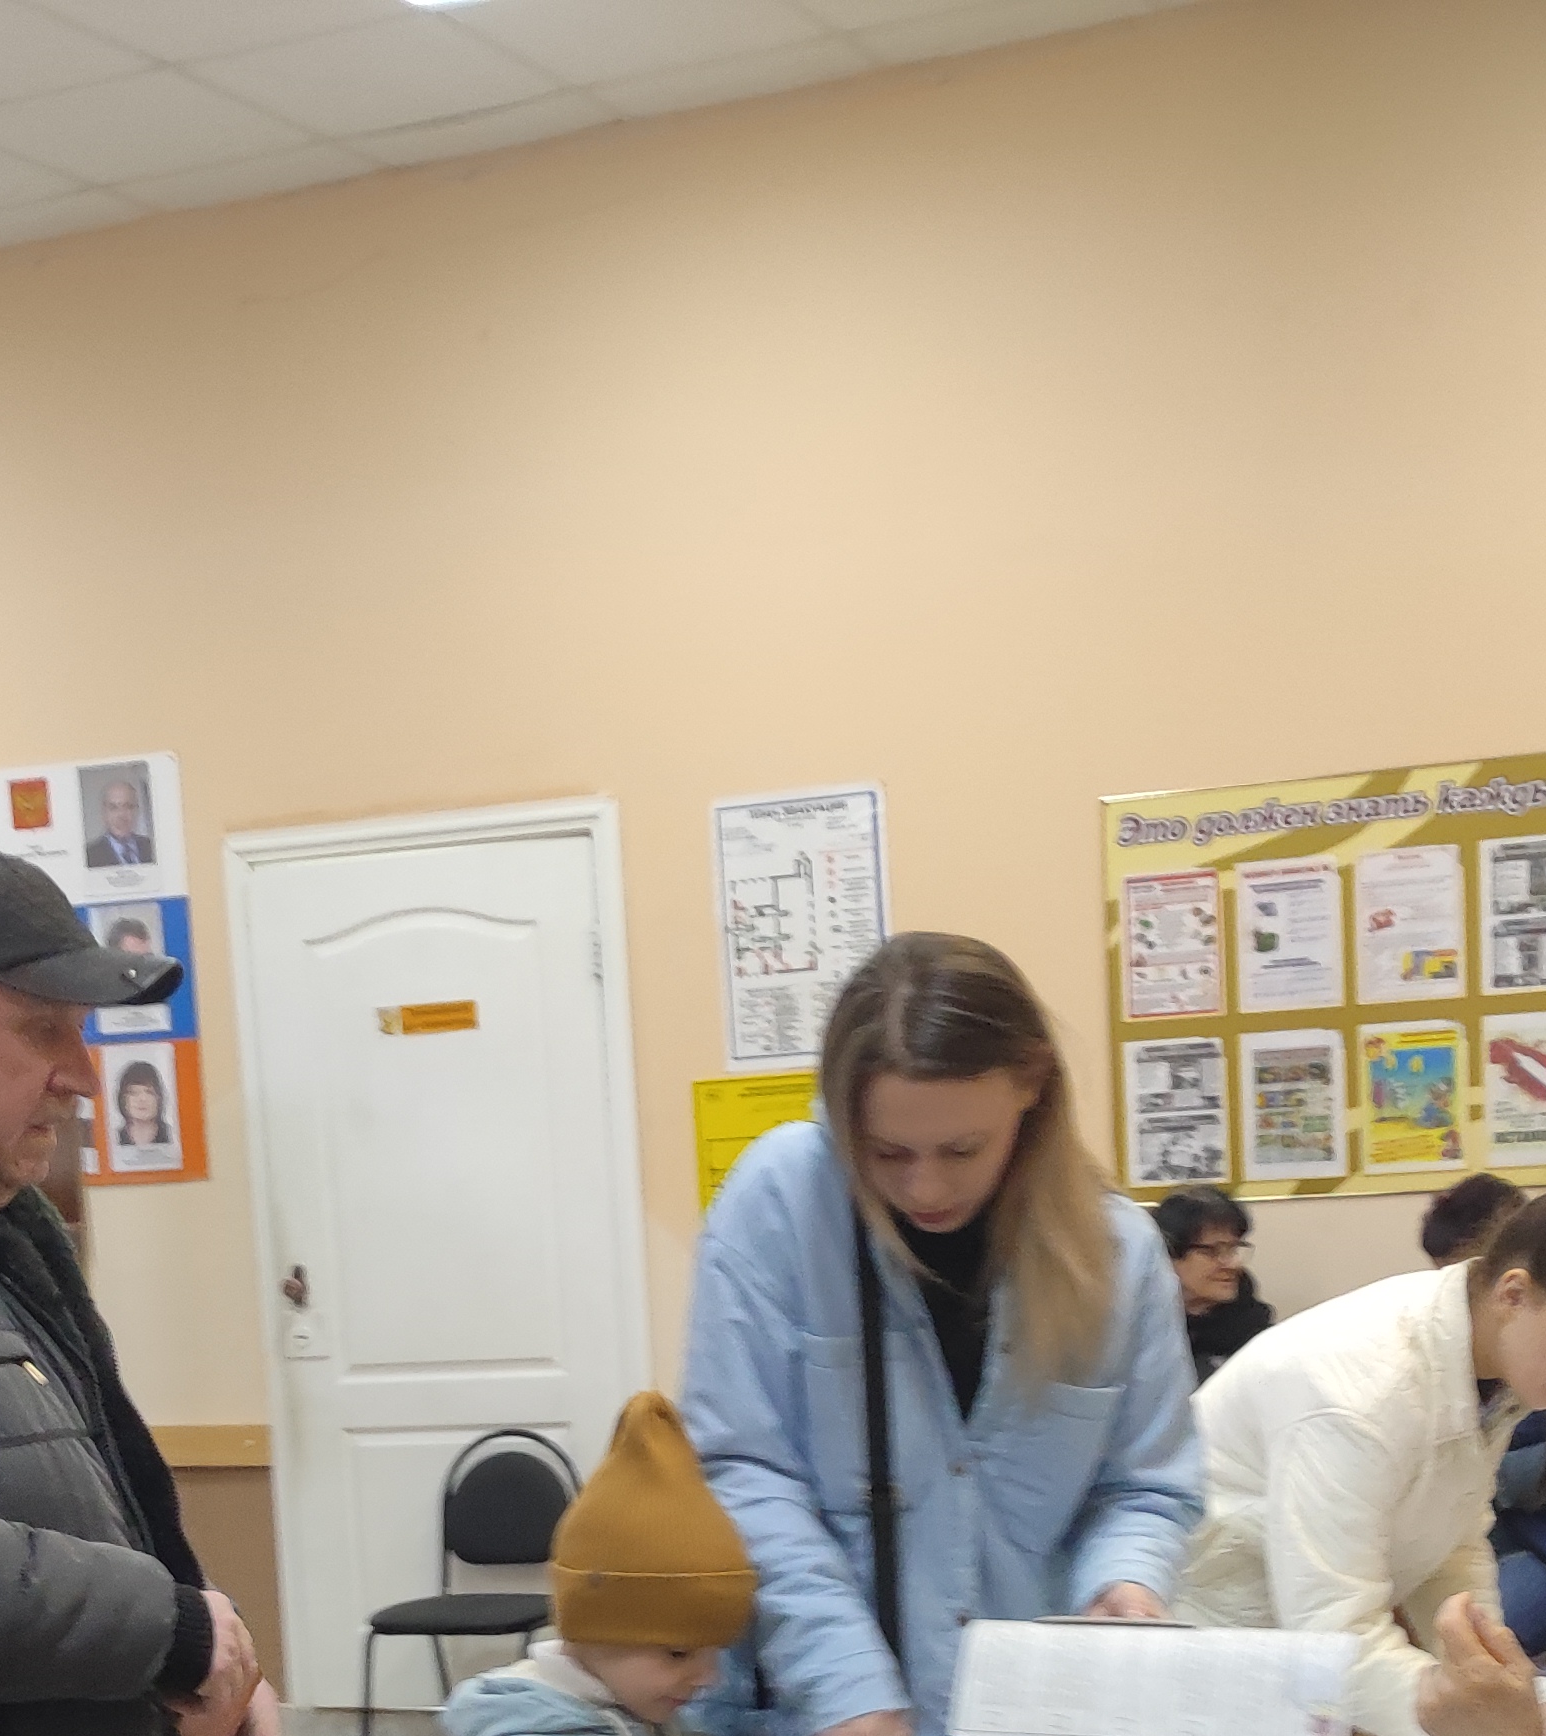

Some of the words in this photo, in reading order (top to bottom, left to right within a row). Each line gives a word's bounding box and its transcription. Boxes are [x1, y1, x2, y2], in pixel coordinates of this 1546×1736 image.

[1117, 812, 1192, 847] Это
[1193, 797, 1322, 847] должен
[1321, 789, 1433, 825] знать
